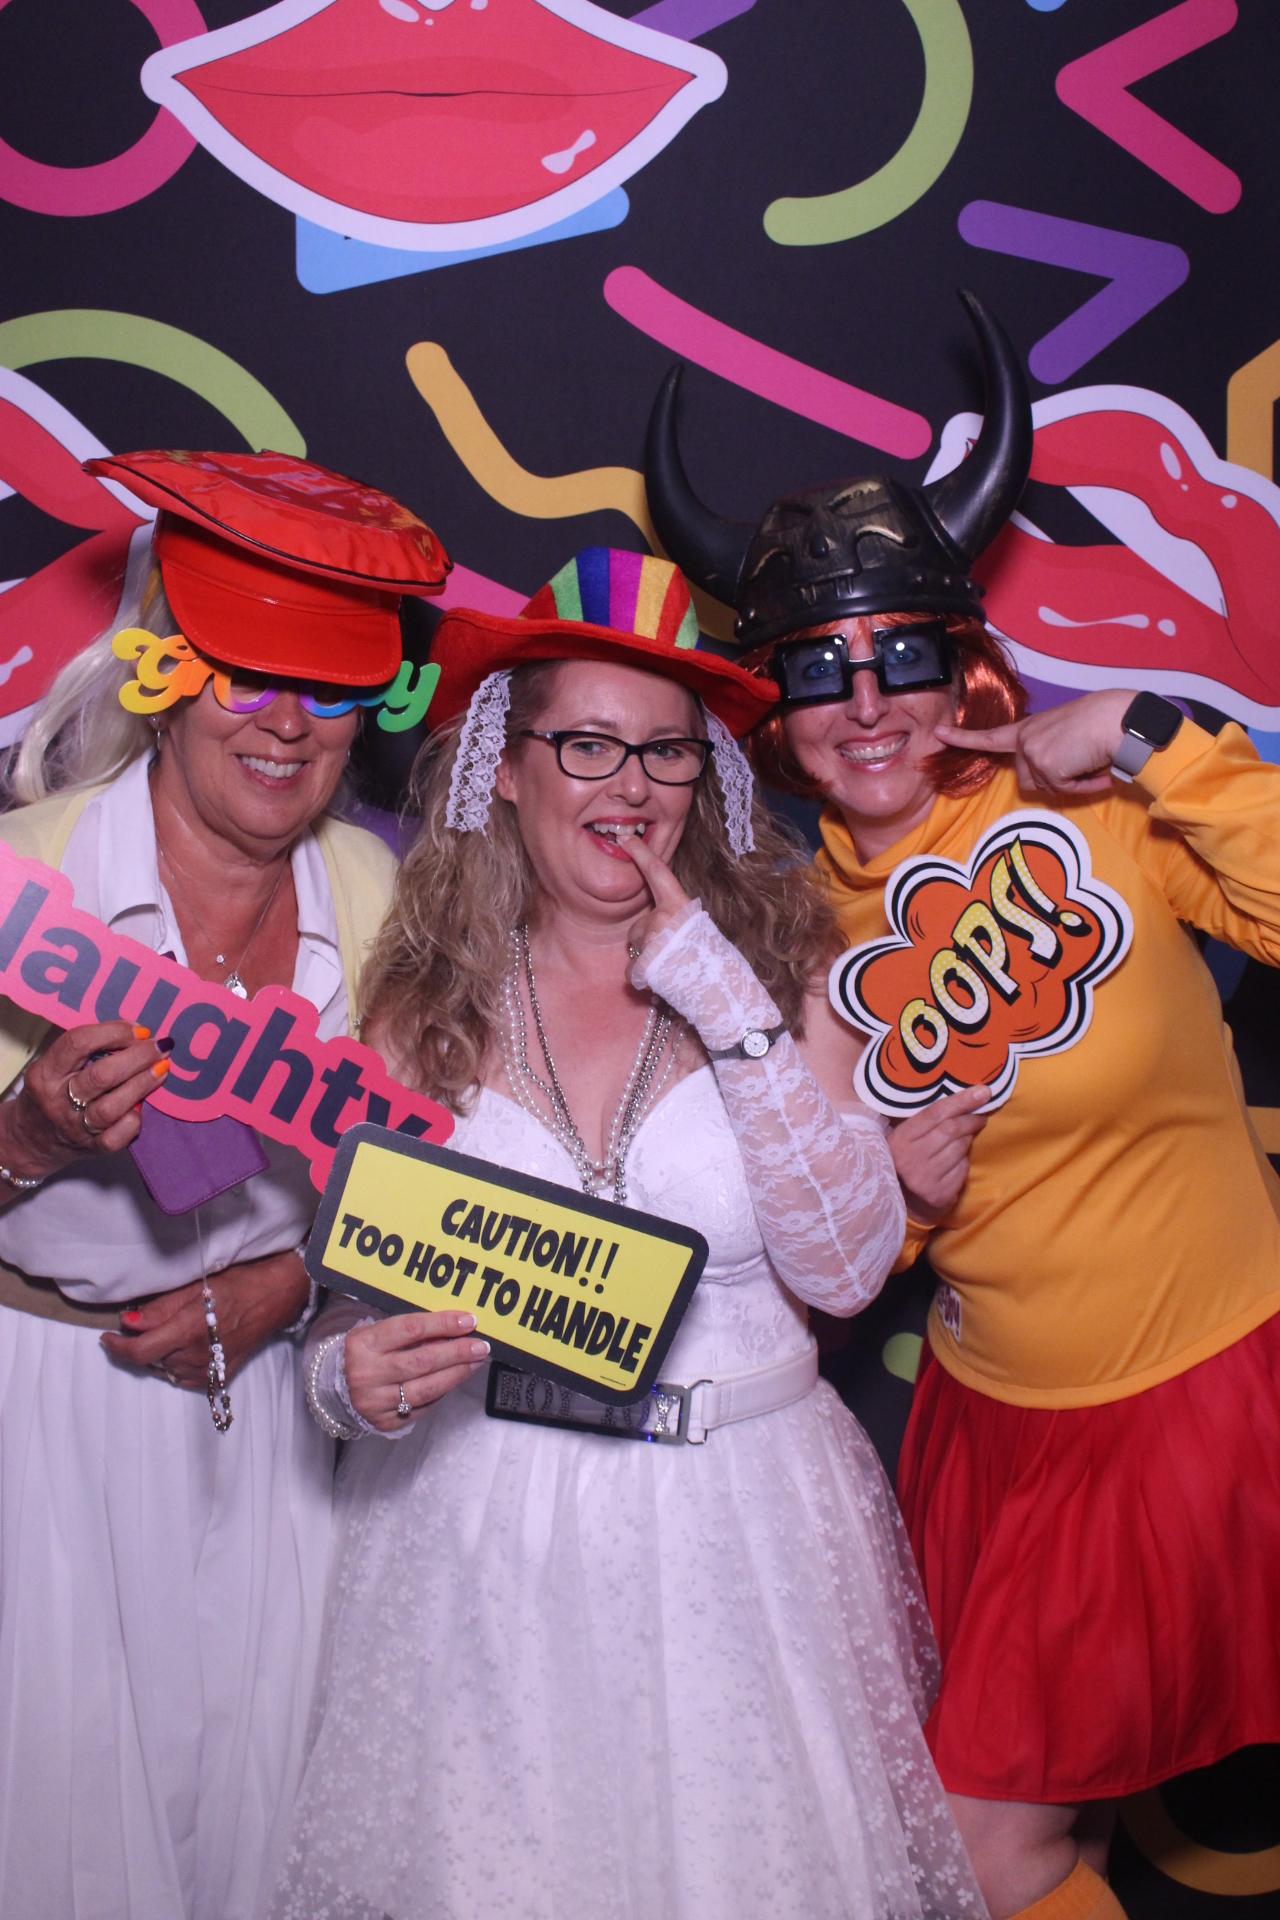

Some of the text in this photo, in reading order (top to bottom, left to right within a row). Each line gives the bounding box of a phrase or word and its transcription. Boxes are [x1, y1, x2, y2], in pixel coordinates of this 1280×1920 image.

[899, 833, 1093, 1074] OOPS!
[338, 1213, 653, 1373] TOO HOT TO HANDLE
[440, 1198, 620, 1294] CAUTION!!
